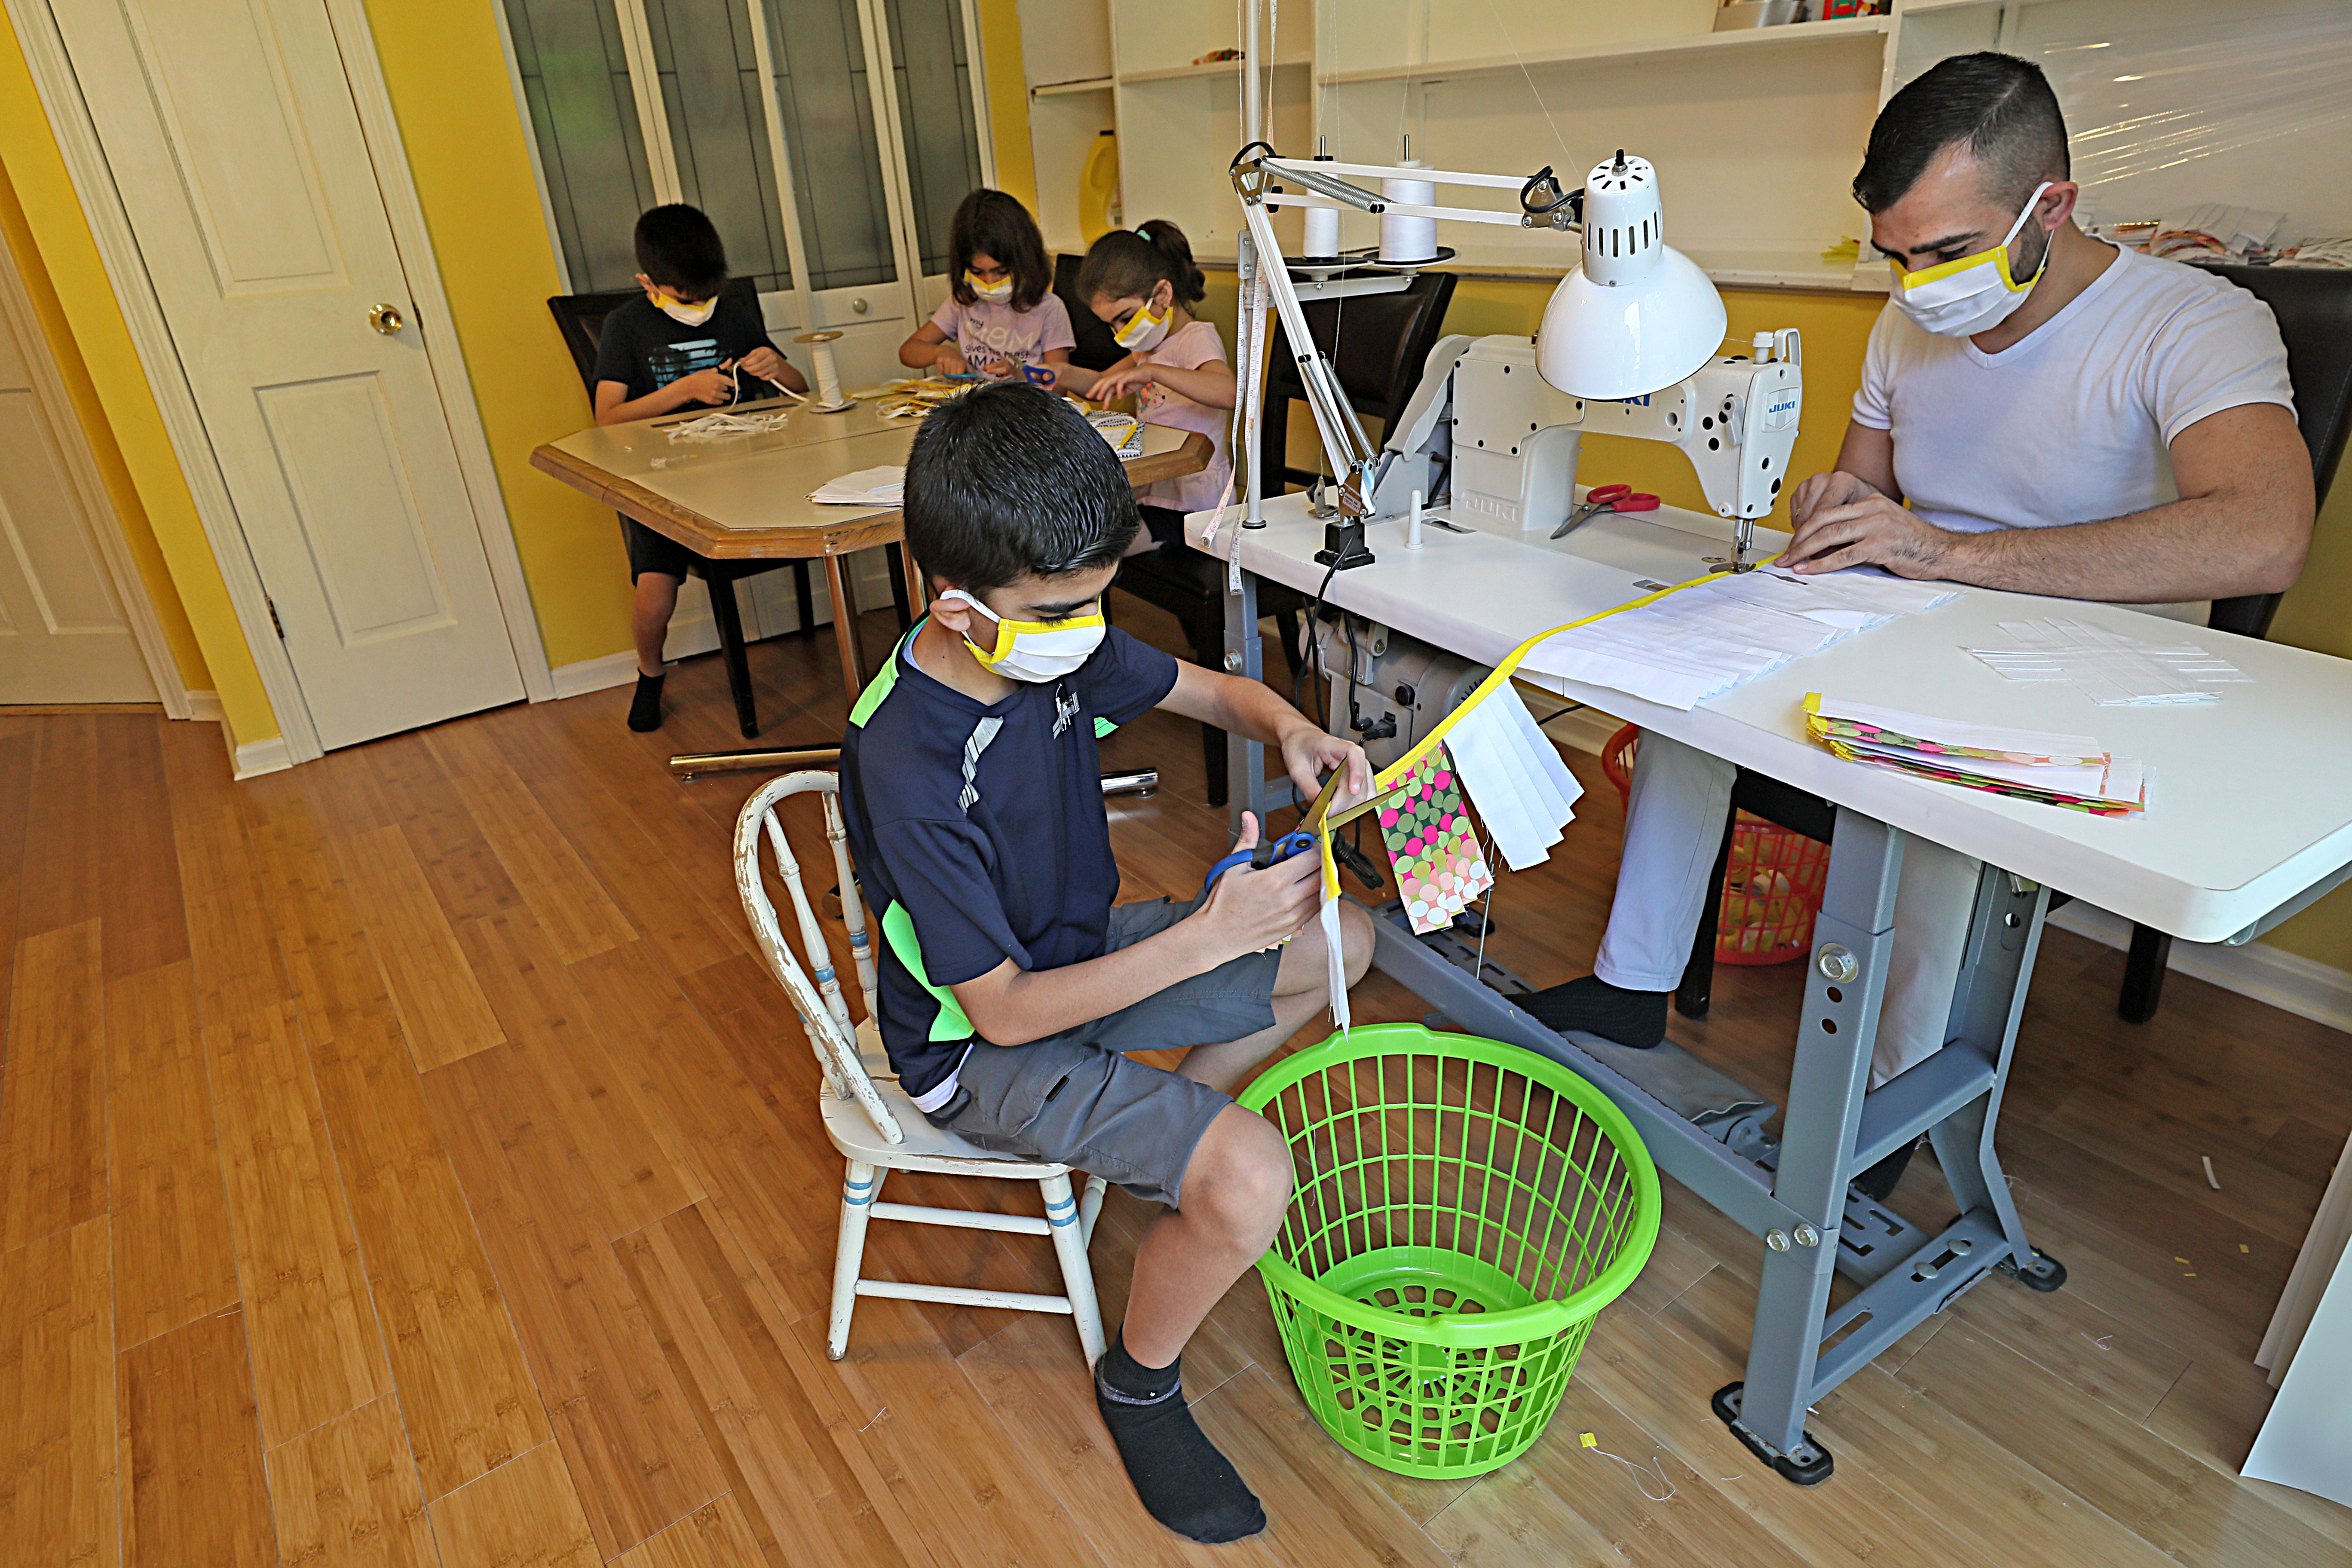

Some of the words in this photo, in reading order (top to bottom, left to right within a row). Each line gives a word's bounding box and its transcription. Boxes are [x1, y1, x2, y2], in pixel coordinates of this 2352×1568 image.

[970, 318, 984, 329] my
[965, 343, 986, 353] gives
[1769, 401, 1796, 413] JUKI
[1466, 497, 1520, 523] JUKI
